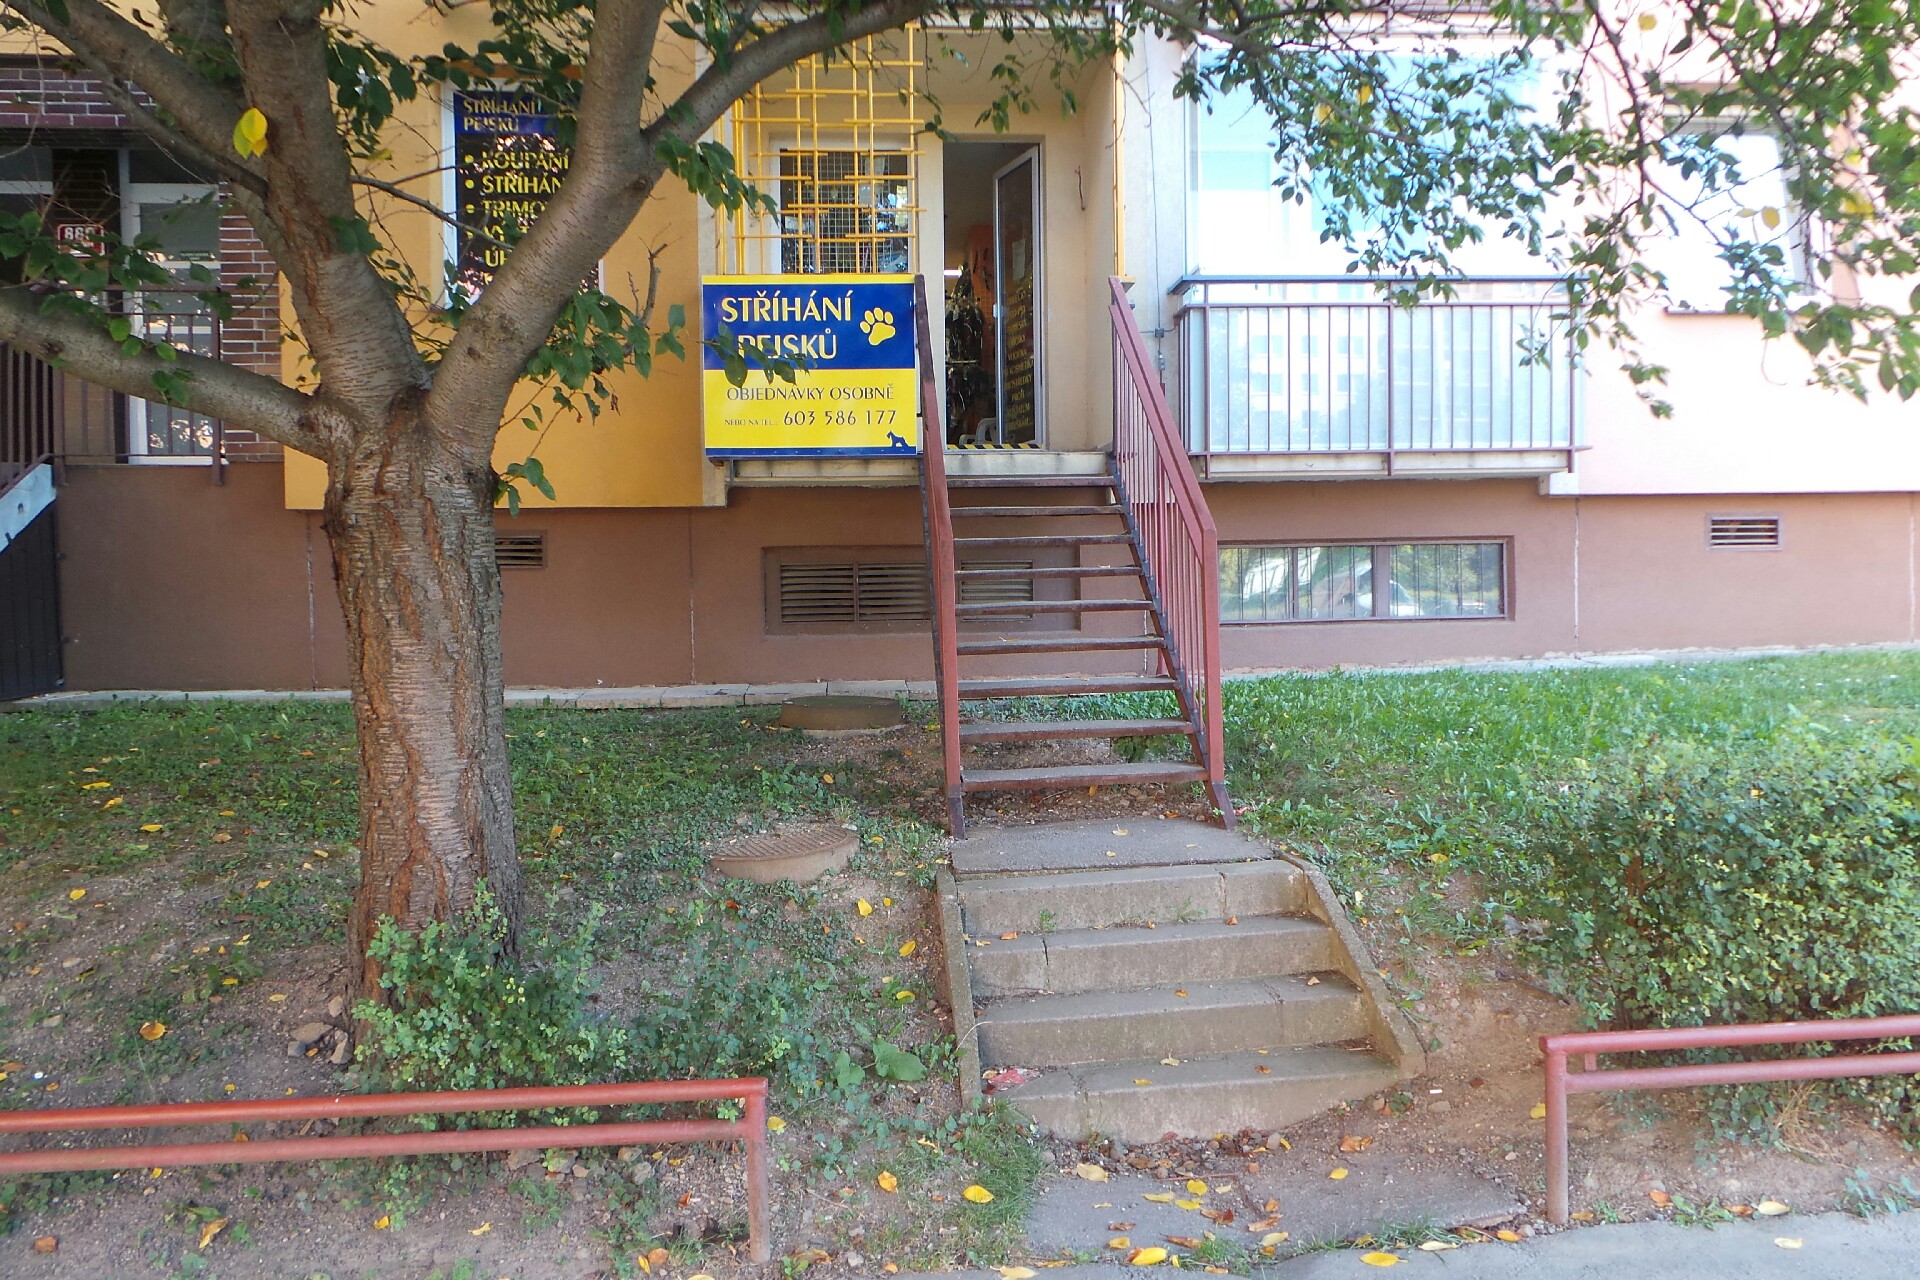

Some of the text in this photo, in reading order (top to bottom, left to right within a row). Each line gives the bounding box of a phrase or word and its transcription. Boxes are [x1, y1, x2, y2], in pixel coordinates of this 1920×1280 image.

[482, 172, 565, 194] STŘÍHÁN
[721, 290, 853, 322] STŘÍHÁNÍ
[829, 383, 894, 400] OSOBNĚ
[783, 411, 816, 426] 603
[825, 411, 857, 426] 586
[866, 410, 897, 425] 177
